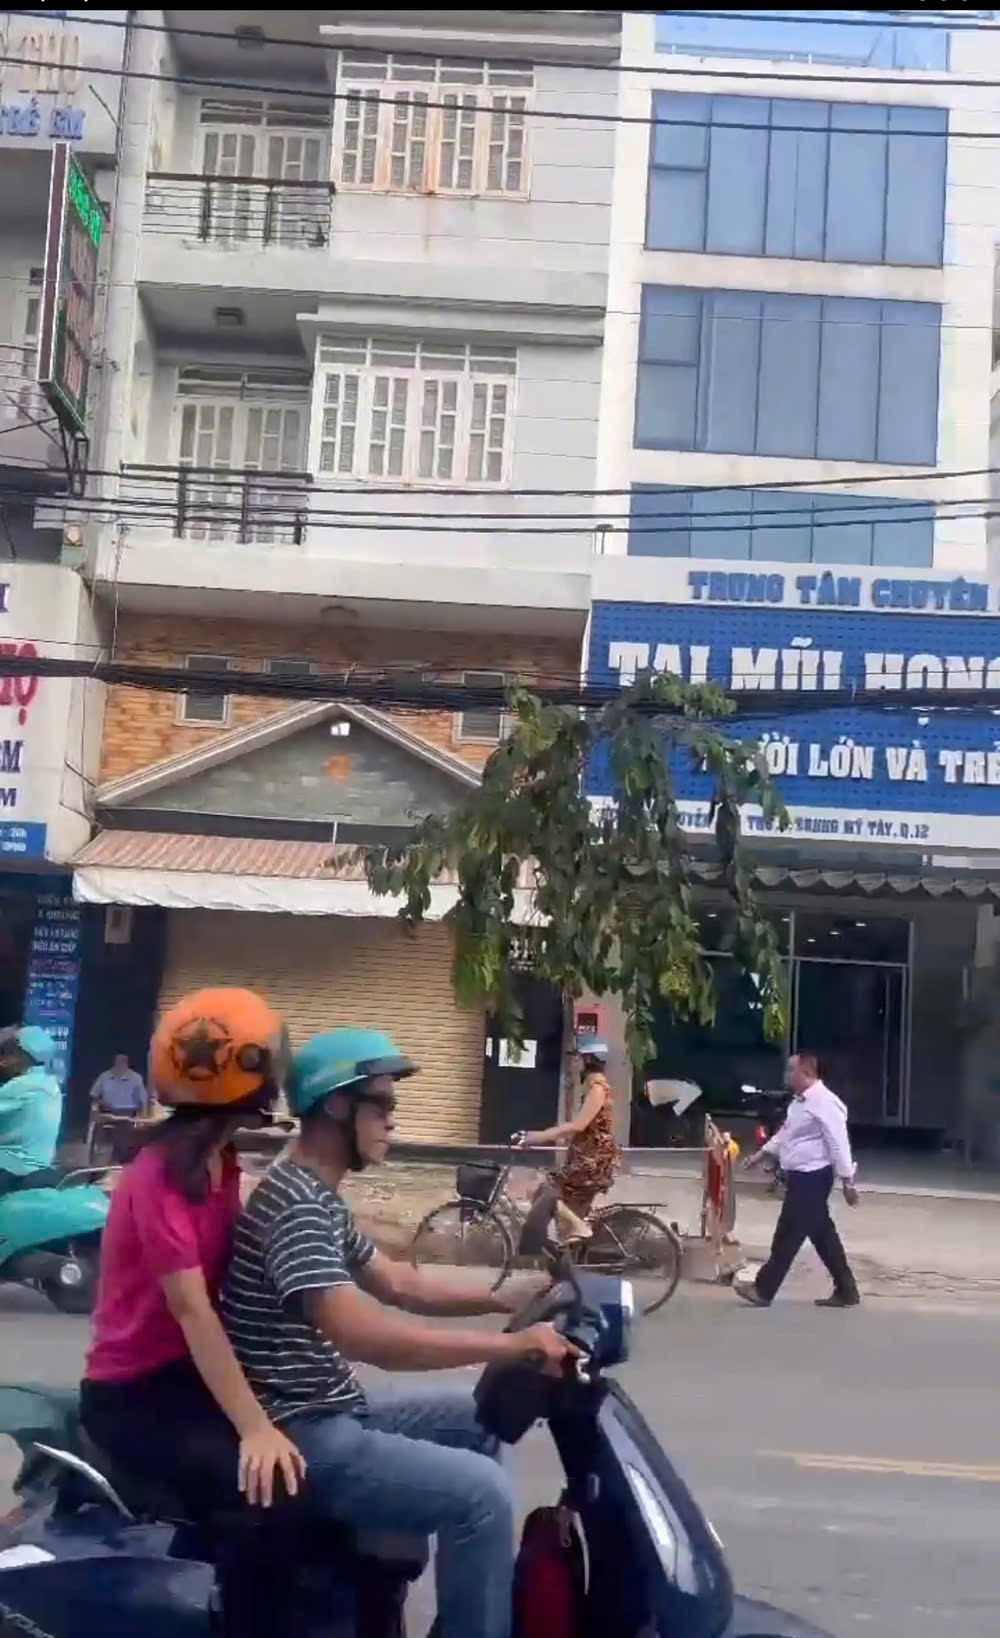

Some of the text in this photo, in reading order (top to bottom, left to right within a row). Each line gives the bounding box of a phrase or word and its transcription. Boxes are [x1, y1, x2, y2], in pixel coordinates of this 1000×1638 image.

[688, 571, 784, 603] TRUNG
[871, 576, 989, 611] CHUYÊN
[608, 641, 710, 690] TAI
[730, 636, 843, 690] MŨI
[807, 734, 874, 780] LỚN
[886, 739, 927, 782] VÀ
